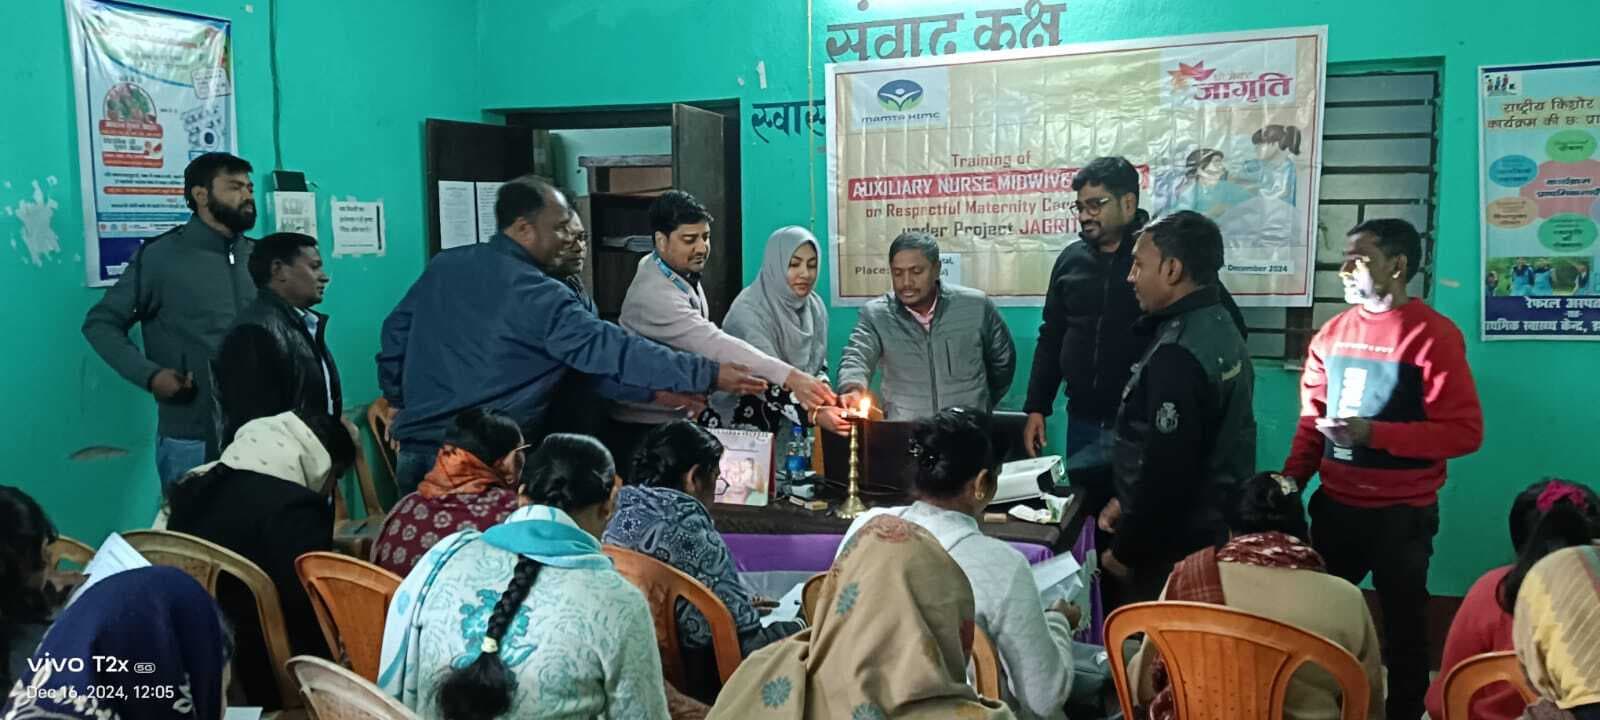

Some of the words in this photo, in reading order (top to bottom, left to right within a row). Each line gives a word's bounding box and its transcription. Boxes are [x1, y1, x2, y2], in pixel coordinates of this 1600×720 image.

[974, 0, 1067, 51] कक्ष
[1192, 73, 1293, 102] जागृति
[1543, 113, 1559, 126] की
[1585, 115, 1600, 126] प्रा
[951, 153, 1012, 168] Training
[1017, 151, 1031, 165] of
[853, 179, 934, 197] AUXILIARY
[939, 176, 993, 193] NURSE
[998, 172, 1074, 191] MIDWIVE
[966, 199, 1037, 215] Maternity
[954, 222, 1013, 238] Project
[1019, 217, 1079, 235] JAGRIT
[1228, 264, 1267, 272] December
[1269, 263, 1288, 272] 2024
